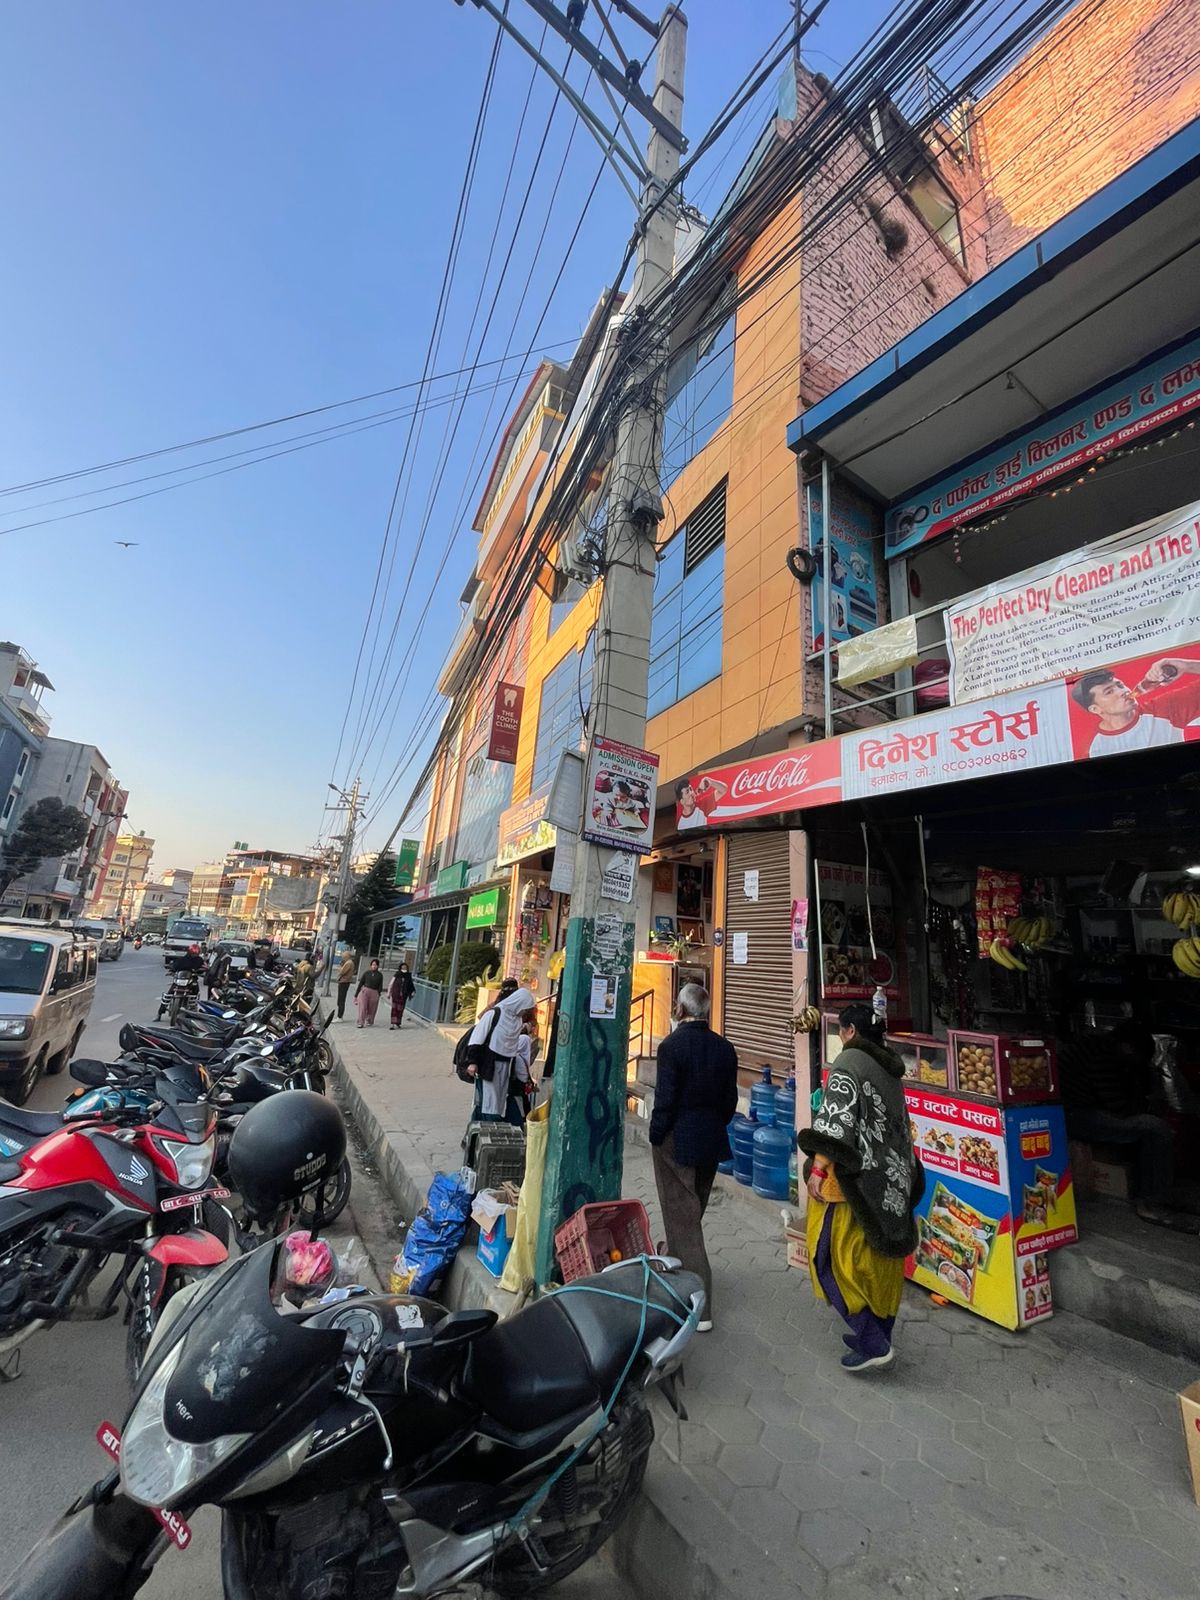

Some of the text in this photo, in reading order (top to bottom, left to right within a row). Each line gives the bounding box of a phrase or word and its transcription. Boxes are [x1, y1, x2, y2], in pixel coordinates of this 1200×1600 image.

[1093, 396, 1132, 429] एण्ड
[1139, 383, 1155, 406] द
[953, 615, 977, 640] The
[979, 593, 1024, 627] Perfect
[1026, 587, 1052, 614] Dry
[1055, 563, 1115, 601] Cleaner
[1119, 544, 1153, 578] and
[1155, 533, 1193, 564] The
[1127, 583, 1137, 593] of
[1042, 648, 1061, 660] Pick
[1077, 637, 1096, 648] and
[1097, 629, 1123, 644] Drop
[1125, 616, 1168, 634] Facility.
[963, 681, 992, 693] Contact
[1004, 671, 1017, 681] for
[1018, 667, 1033, 677] the
[1083, 646, 1103, 657] and
[1104, 624, 1172, 651] Refreshment
[1174, 618, 1186, 628] of
[495, 721, 518, 731] CLINIC
[496, 714, 519, 726] TOOTH
[501, 709, 515, 718] THE
[858, 699, 1041, 773] दिनेश स्टोर्स
[598, 750, 655, 774] ADMISSION OPEN
[922, 1099, 959, 1119] चटपटे
[961, 1108, 997, 1128] पसल
[118, 1172, 144, 1186] HONDA
[294, 1152, 327, 1182] STUDDS
